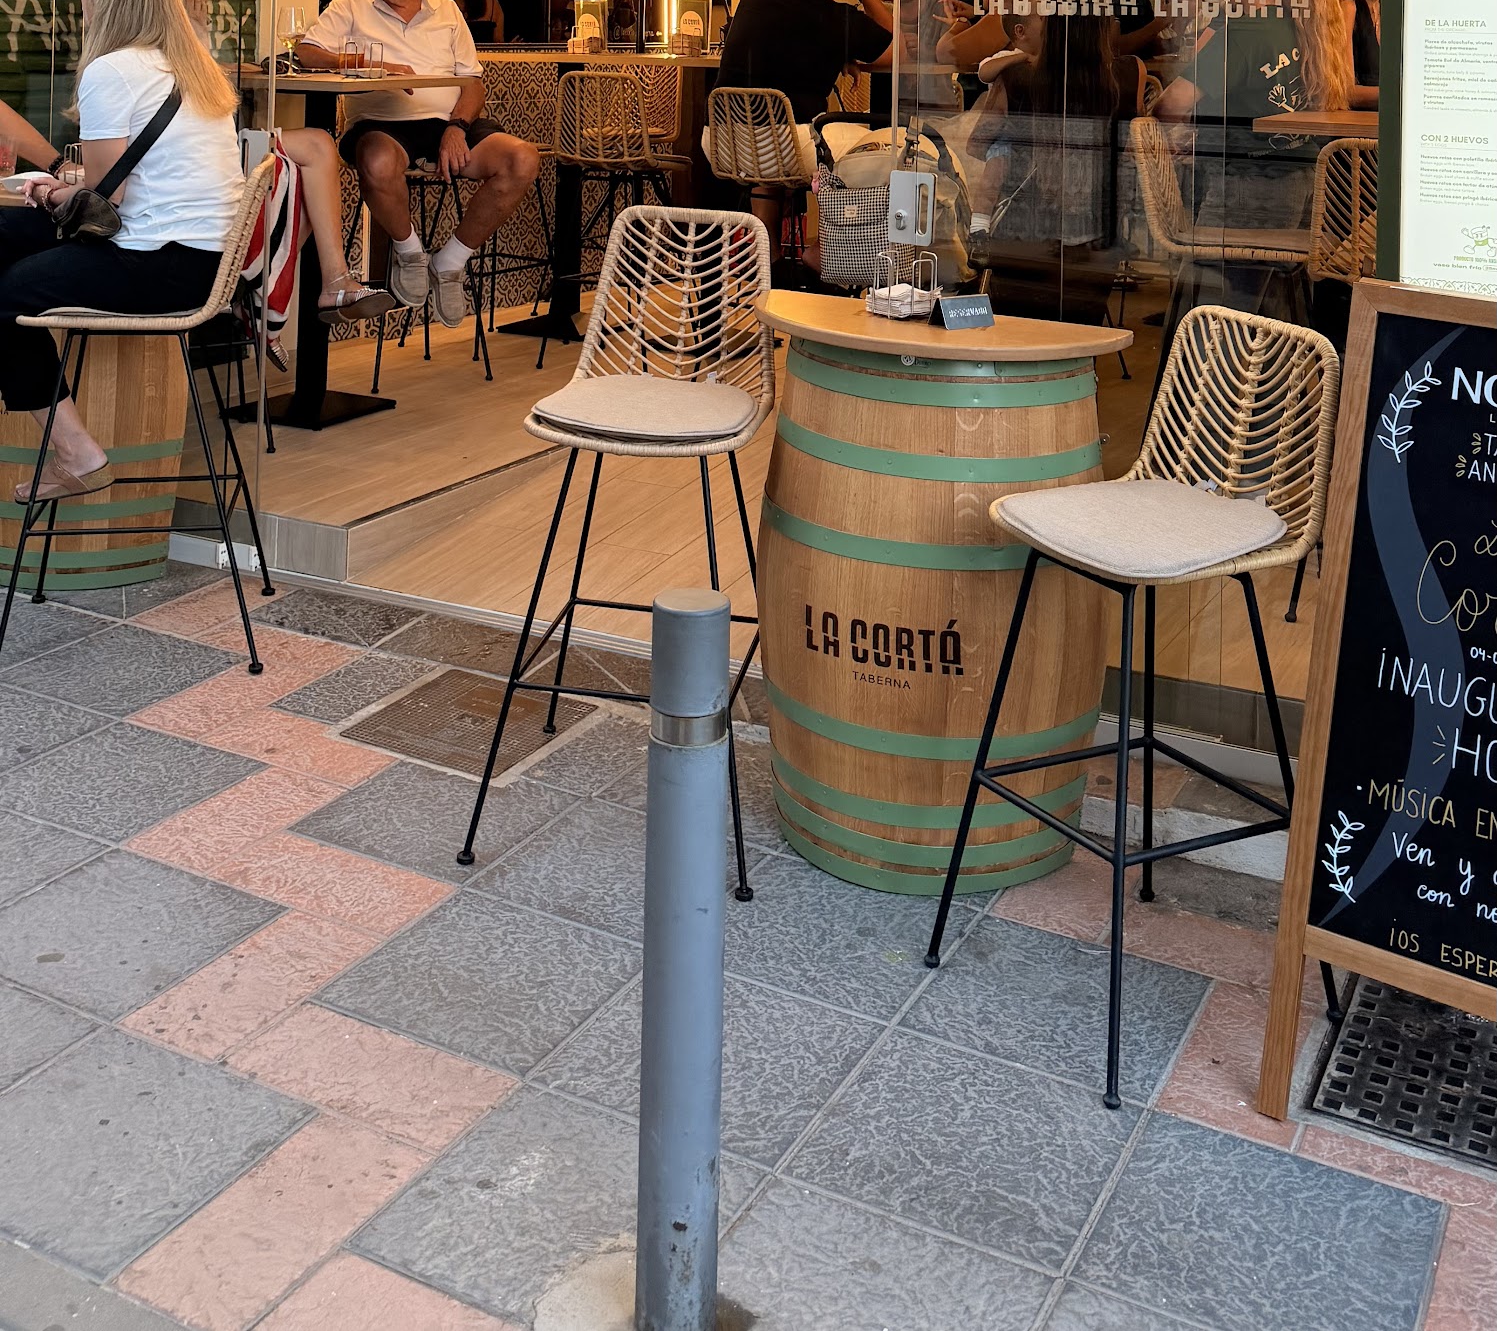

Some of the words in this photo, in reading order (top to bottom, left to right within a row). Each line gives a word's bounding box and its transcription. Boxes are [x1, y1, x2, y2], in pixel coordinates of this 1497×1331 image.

[1425, 19, 1436, 27] DE
[1421, 134, 1442, 143] CON
[1443, 135, 1449, 143] 2
[1451, 136, 1489, 145] HUEVOS
[805, 604, 840, 658] LA
[850, 618, 964, 676] CORTÁ
[852, 670, 911, 690] TABERNA
[1392, 830, 1436, 867] Ven
[1459, 857, 1475, 896] y
[1417, 883, 1455, 909] con
